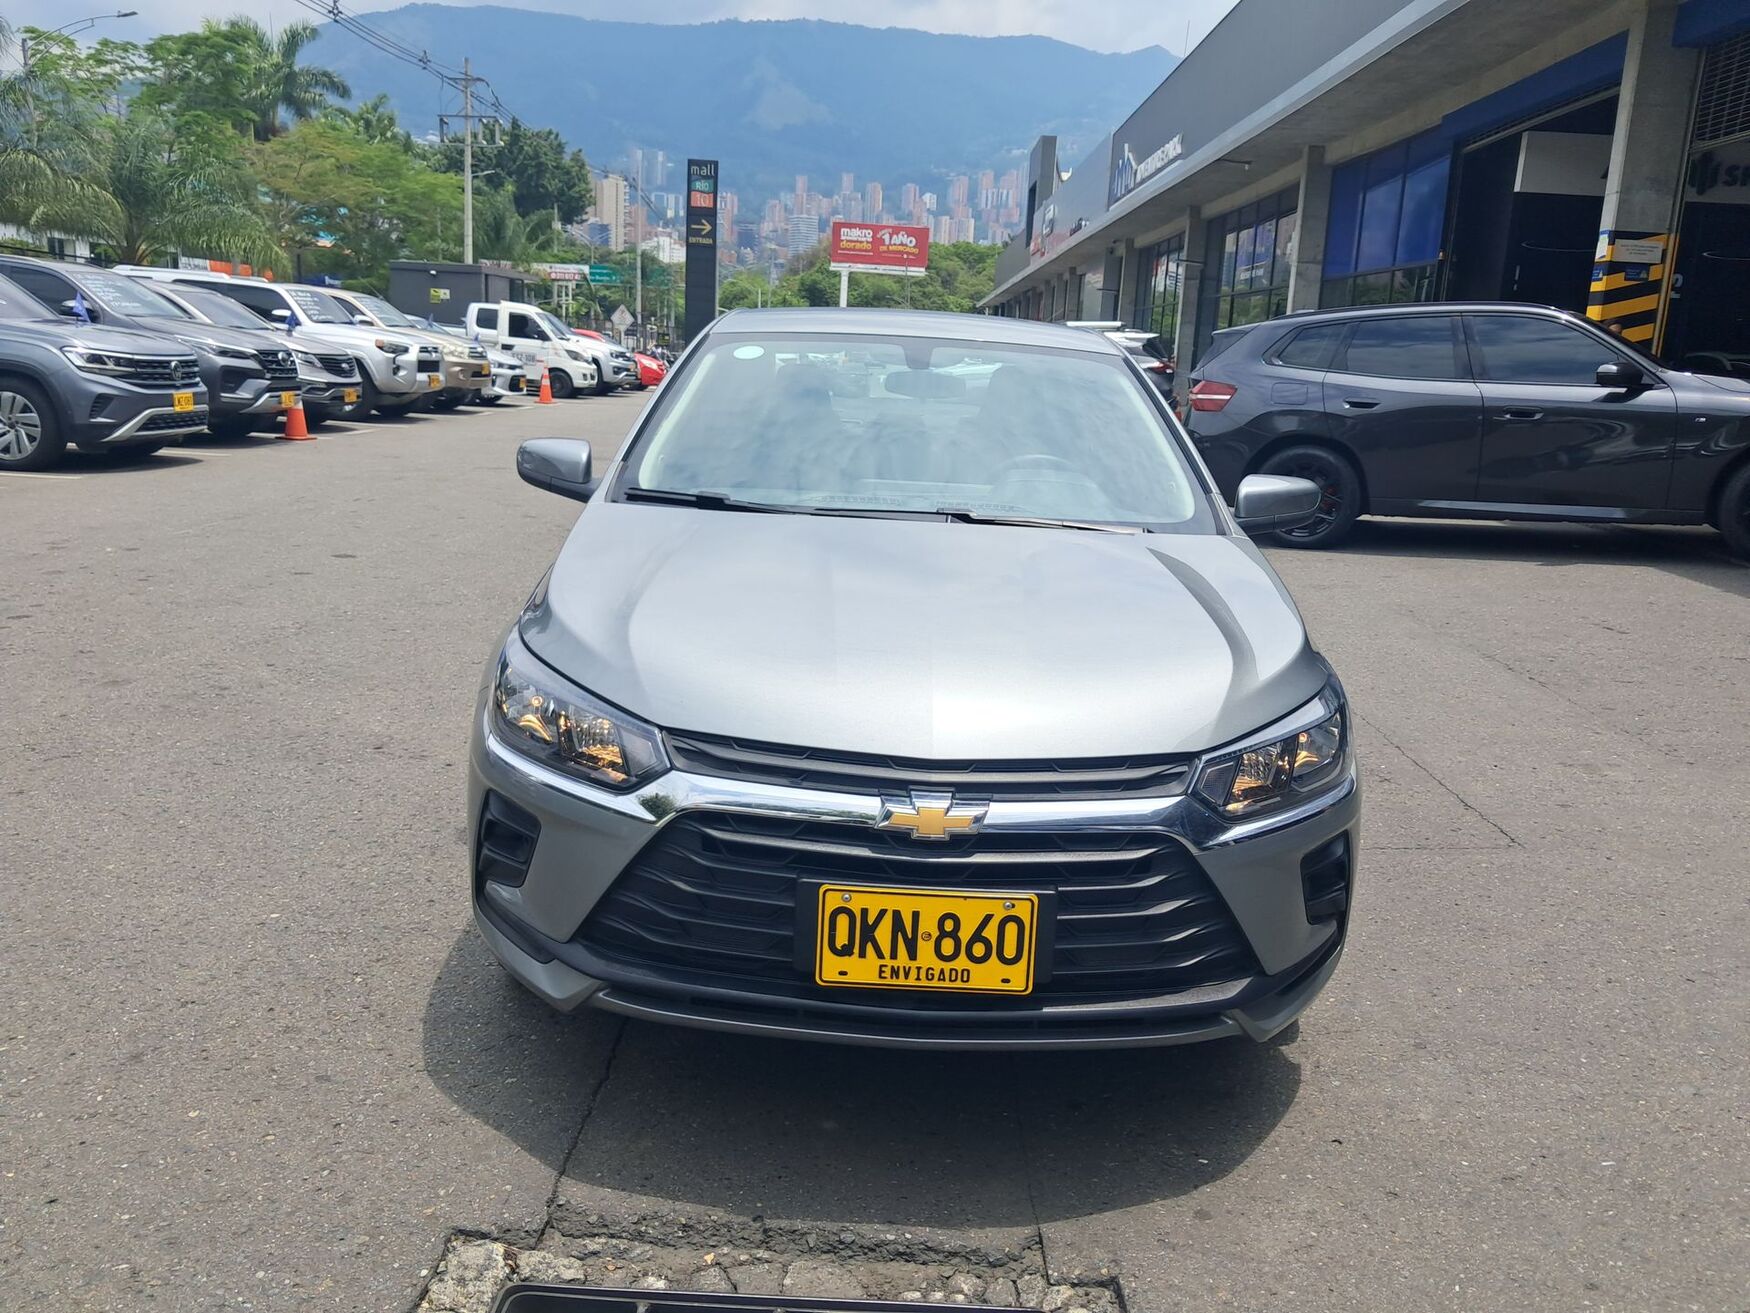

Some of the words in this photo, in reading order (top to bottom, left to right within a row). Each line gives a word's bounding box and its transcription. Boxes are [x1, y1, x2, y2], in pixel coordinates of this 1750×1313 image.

[691, 164, 715, 176] mall
[841, 227, 873, 238] makro
[840, 240, 872, 250] dorado
[891, 231, 917, 247] AÑO
[889, 245, 919, 255] MERCADO
[828, 906, 920, 961] QKN
[934, 912, 1025, 966] 860
[878, 964, 971, 983] ENVIGADO
